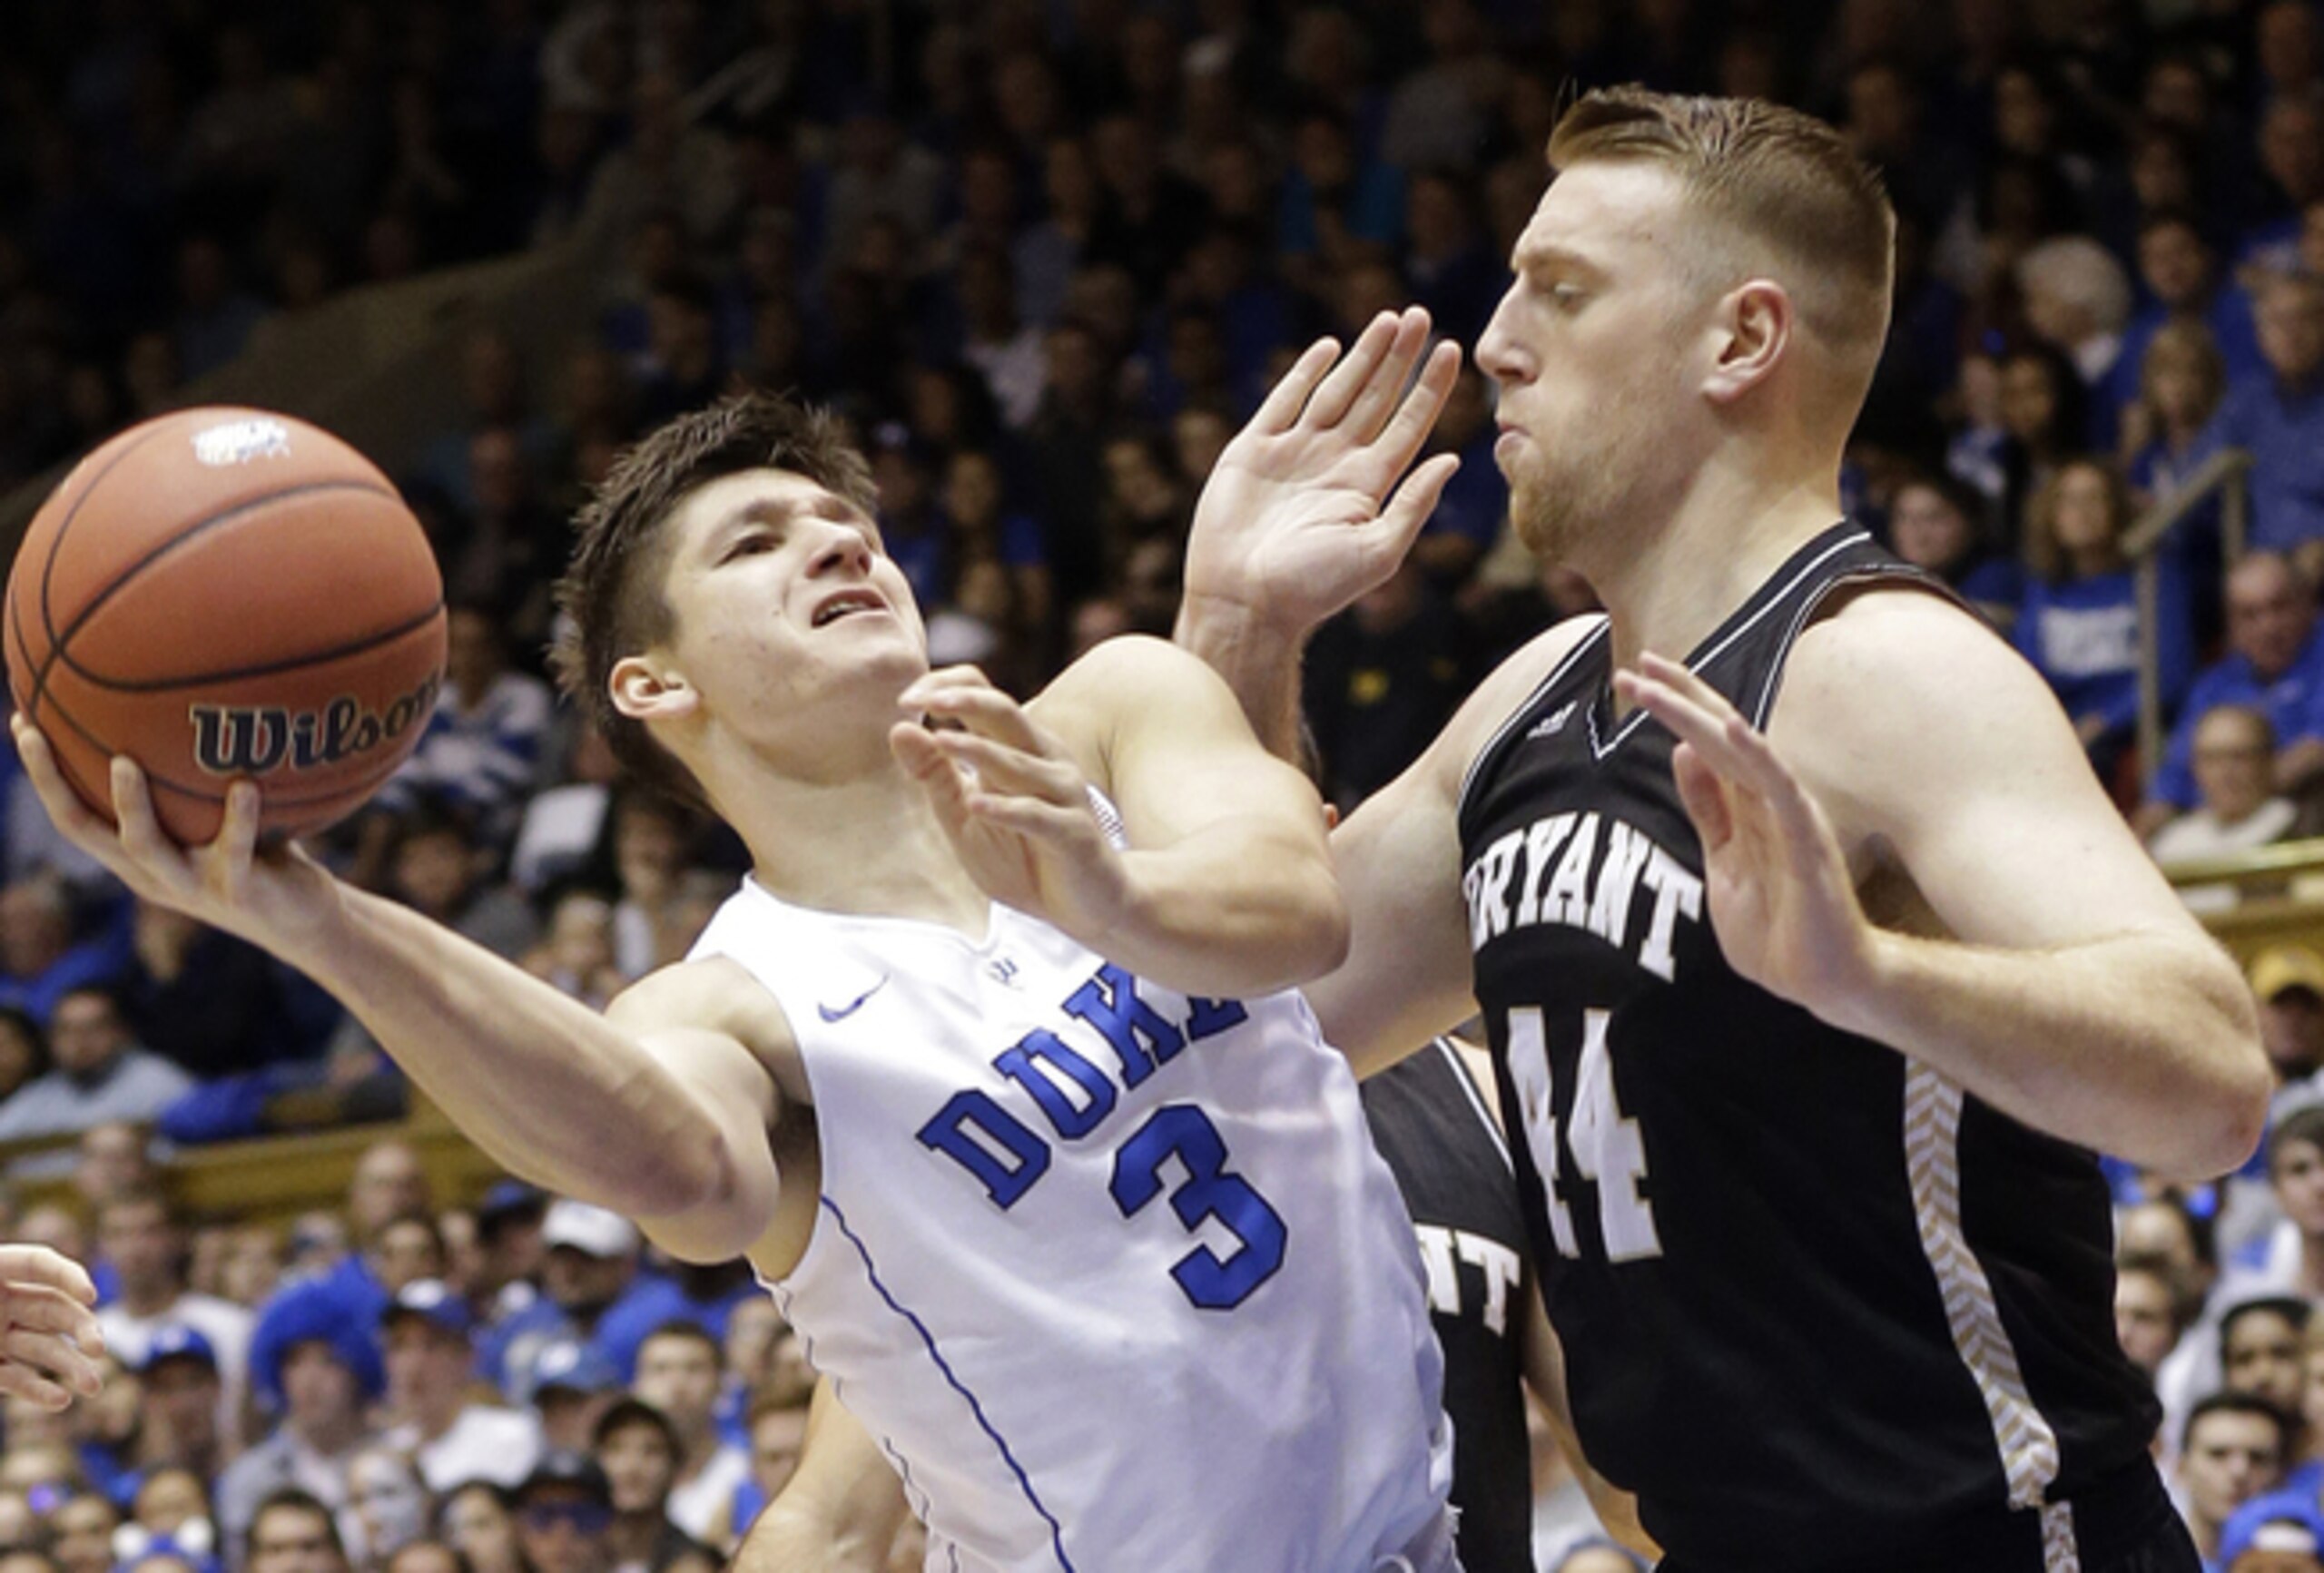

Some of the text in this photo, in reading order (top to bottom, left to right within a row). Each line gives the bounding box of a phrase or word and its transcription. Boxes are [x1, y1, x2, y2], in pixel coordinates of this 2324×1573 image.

[189, 670, 441, 776] Wilson
[1462, 811, 1705, 984] BRYANT
[1108, 1103, 1288, 1311] 3
[1505, 1004, 1664, 1263] 44
